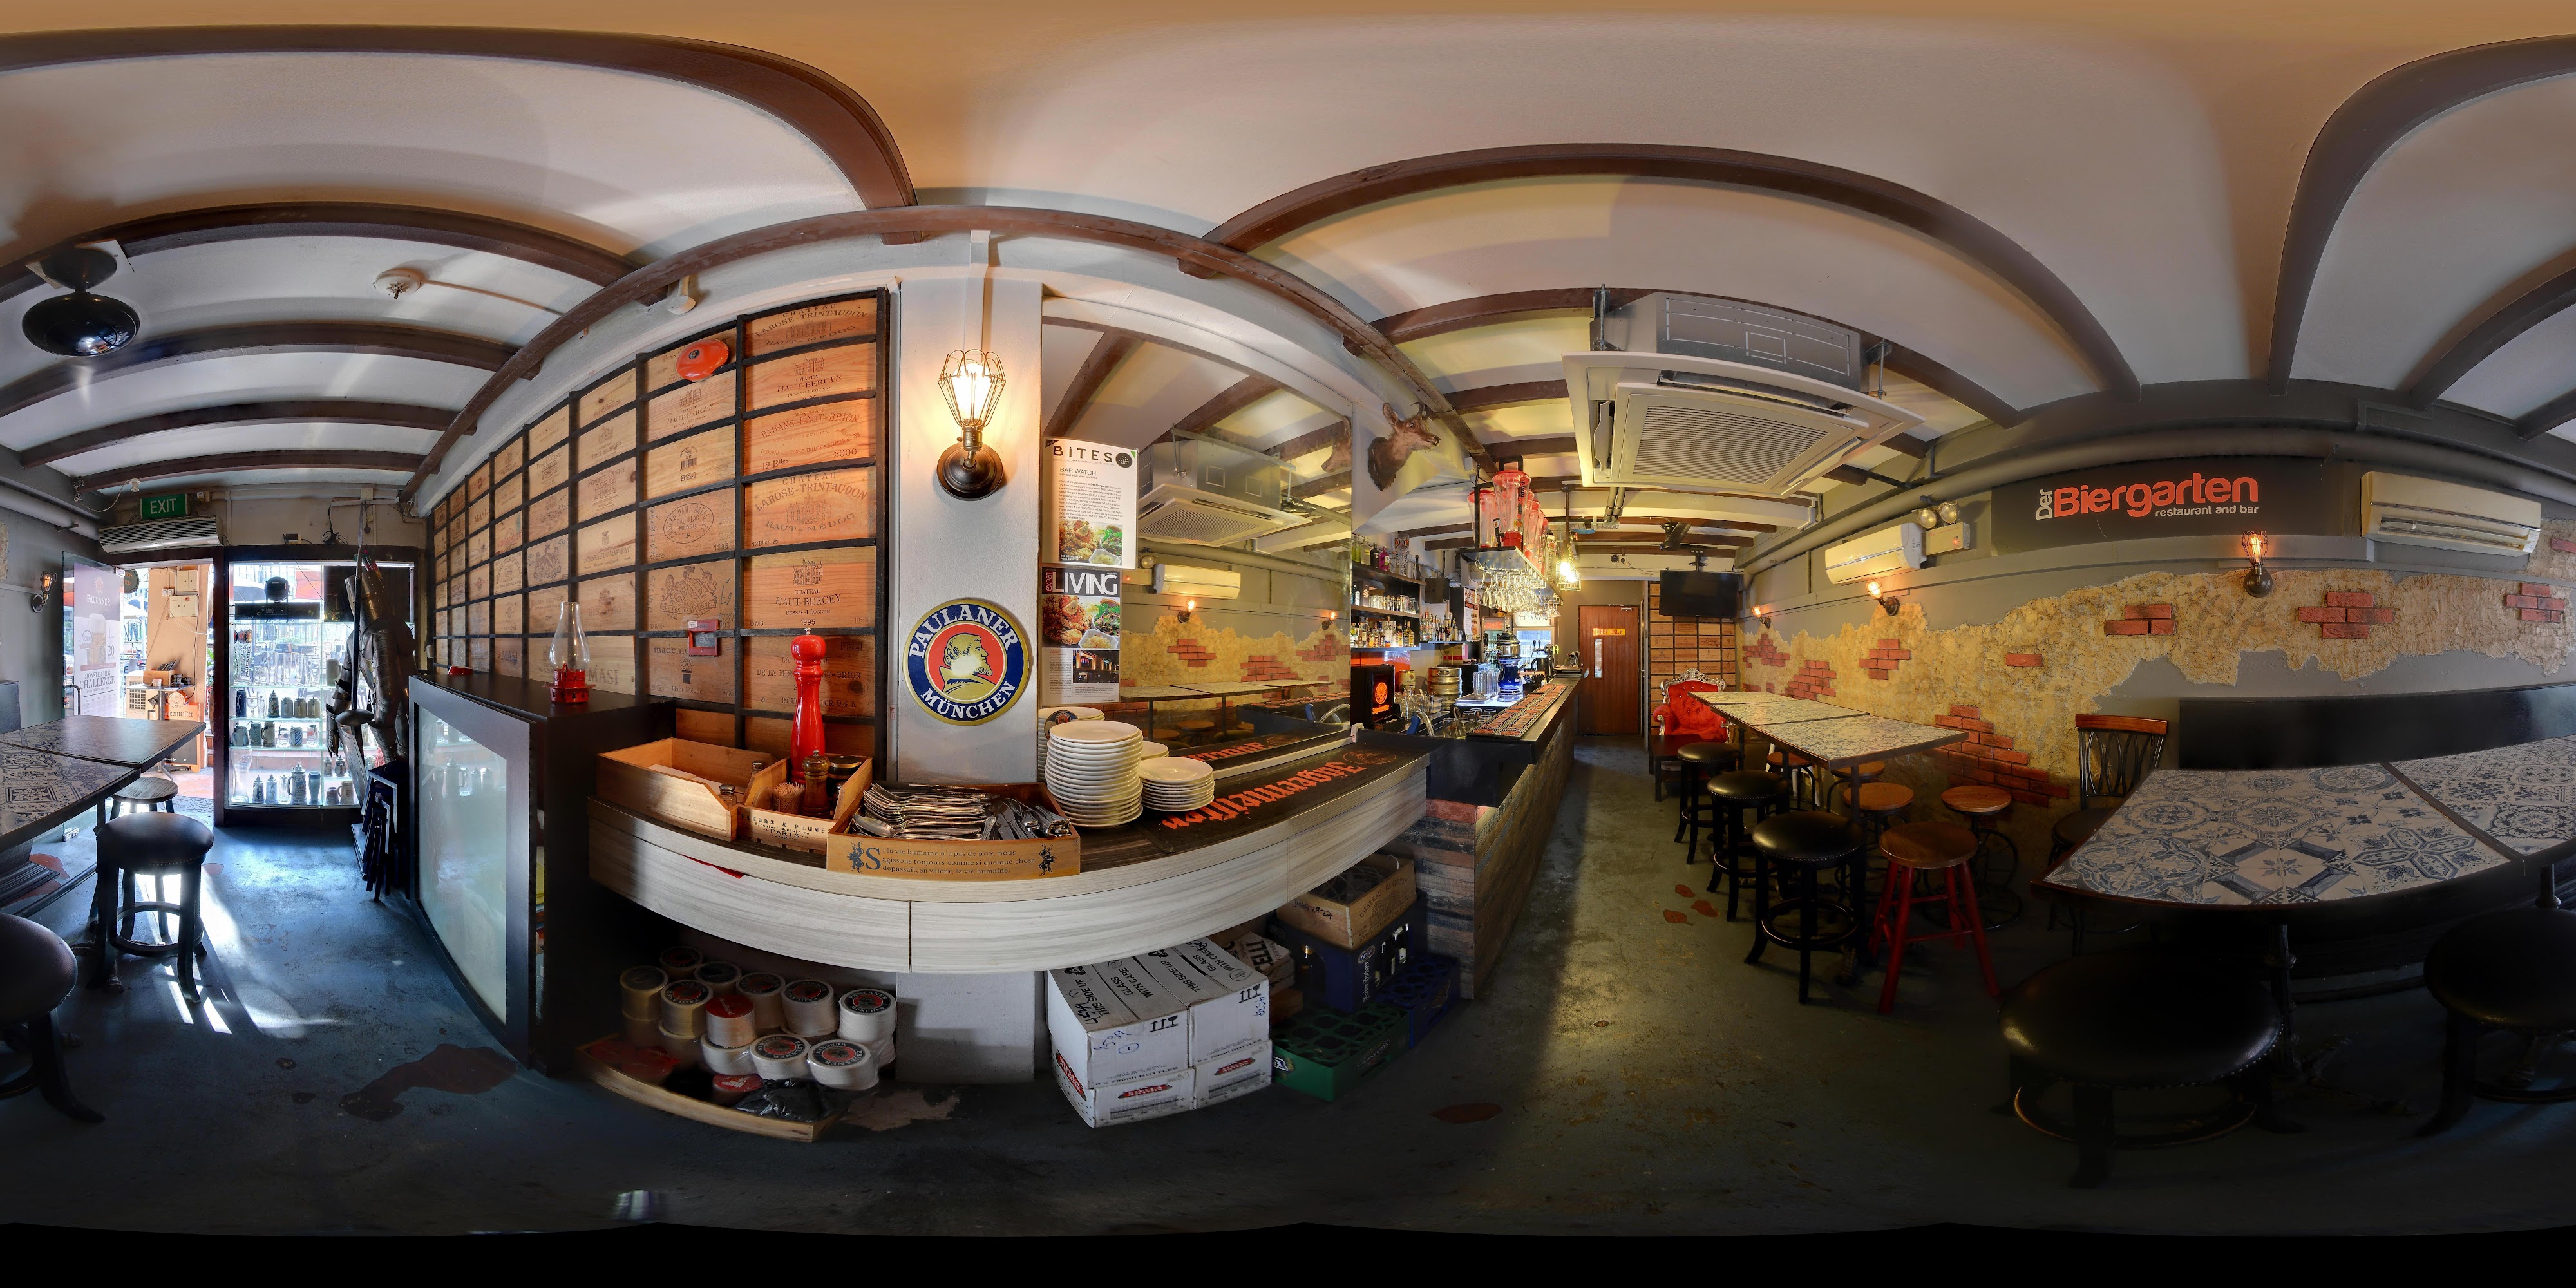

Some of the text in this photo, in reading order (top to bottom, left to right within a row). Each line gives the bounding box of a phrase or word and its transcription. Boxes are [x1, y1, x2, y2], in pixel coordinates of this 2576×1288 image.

[782, 303, 837, 317] CHATEAU
[761, 420, 795, 438] BAHANS
[833, 448, 857, 458] 2000
[782, 472, 837, 485] CHATEAU
[2036, 473, 2258, 520] Der Biergarten
[150, 498, 176, 514] EXIT
[2155, 504, 2259, 517] restaurant and bar
[677, 515, 699, 524] PAUILLAC
[1052, 571, 1117, 595] LIVING
[86, 594, 110, 606] PAULANER
[909, 605, 1018, 658] PAULANER
[108, 645, 115, 656] 20
[79, 676, 115, 690] CHALLENGE
[588, 669, 618, 685] MASI
[920, 681, 1016, 719] MÜNCHEN
[741, 814, 775, 824] FLEURS
[770, 829, 799, 838] PARIS
[882, 865, 918, 873] dépassait,
[1359, 889, 1382, 918] CHATEAU
[1193, 954, 1217, 971] GLASS
[1215, 956, 1236, 972] WITH
[1075, 978, 1087, 989] UP
[1119, 966, 1153, 999] WITH CARE
[1160, 960, 1203, 992] THIS SIDE UP
[1110, 976, 1134, 996] GLASS
[849, 991, 887, 1000] PAULANER
[1082, 990, 1103, 1009] SIDE
[1092, 1004, 1110, 1017] THIS
[772, 1040, 806, 1059] PAULANER
[824, 1050, 864, 1066] PAULANER
[1139, 1066, 1179, 1078] BOTTLES
